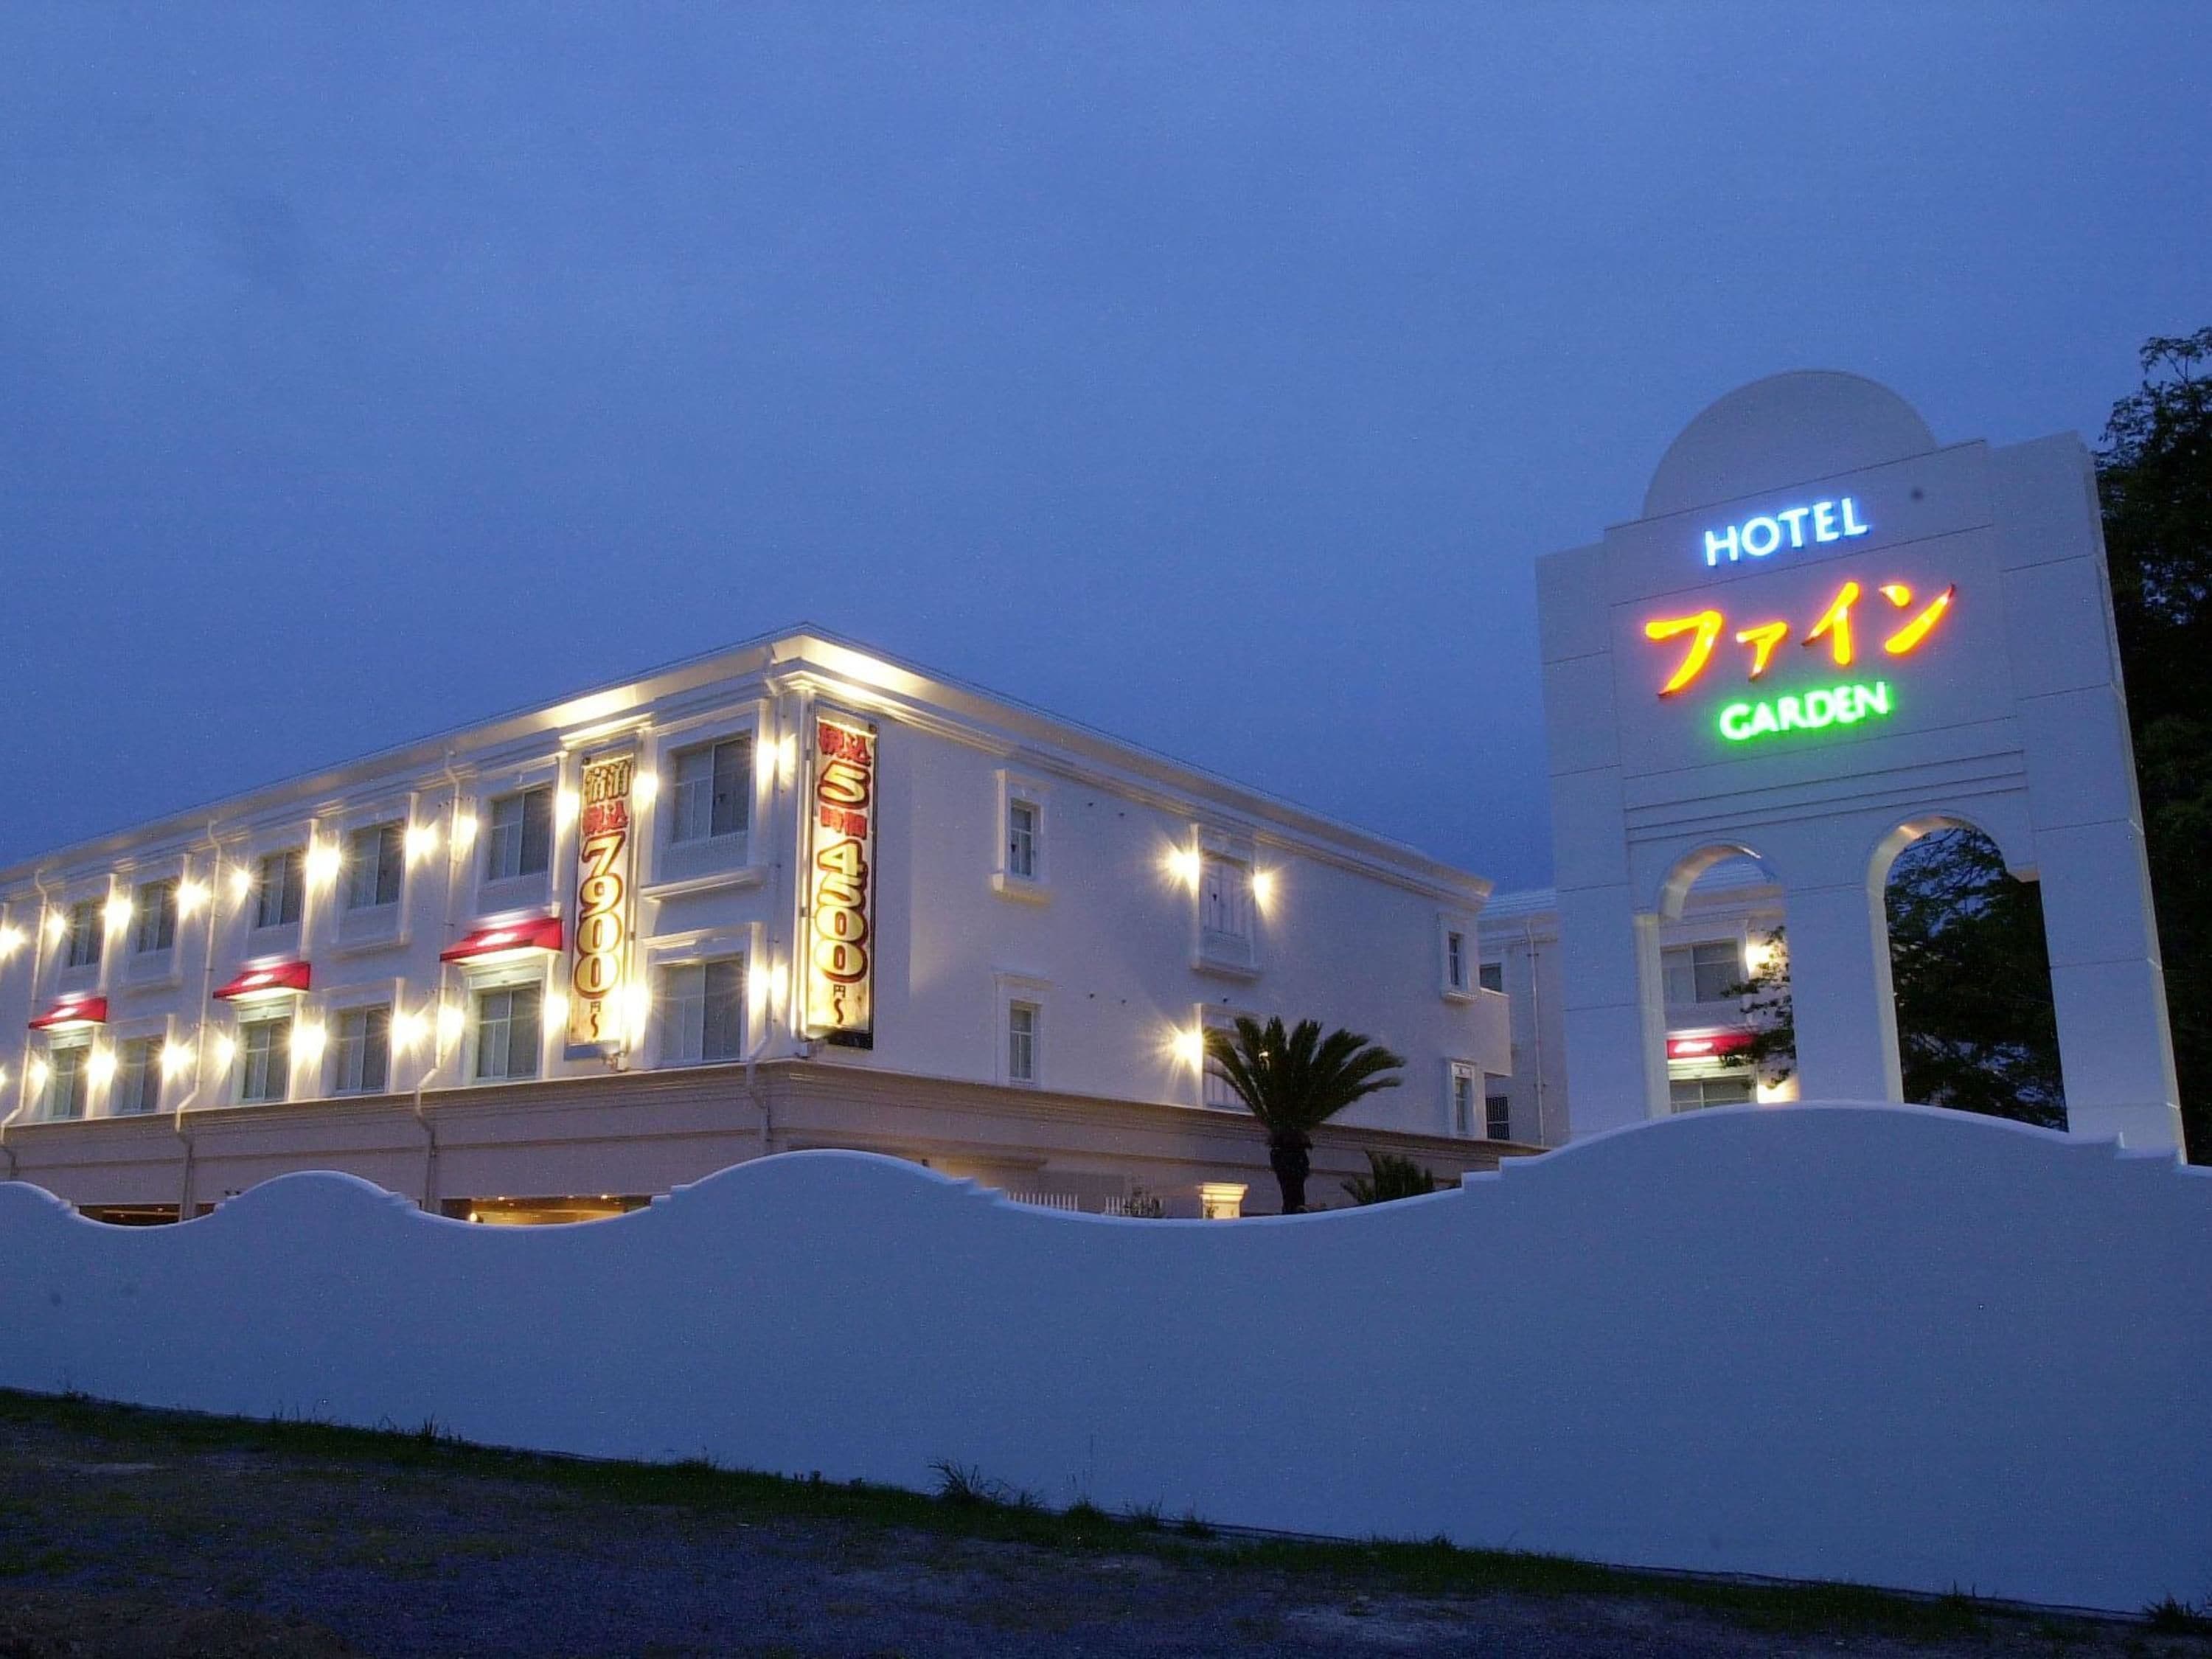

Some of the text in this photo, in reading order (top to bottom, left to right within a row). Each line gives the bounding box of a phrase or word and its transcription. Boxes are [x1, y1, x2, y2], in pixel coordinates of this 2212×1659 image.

[1703, 497, 1869, 567] HOTEL
[1644, 581, 1955, 697] ファイン
[1718, 681, 1891, 741] GARDEN
